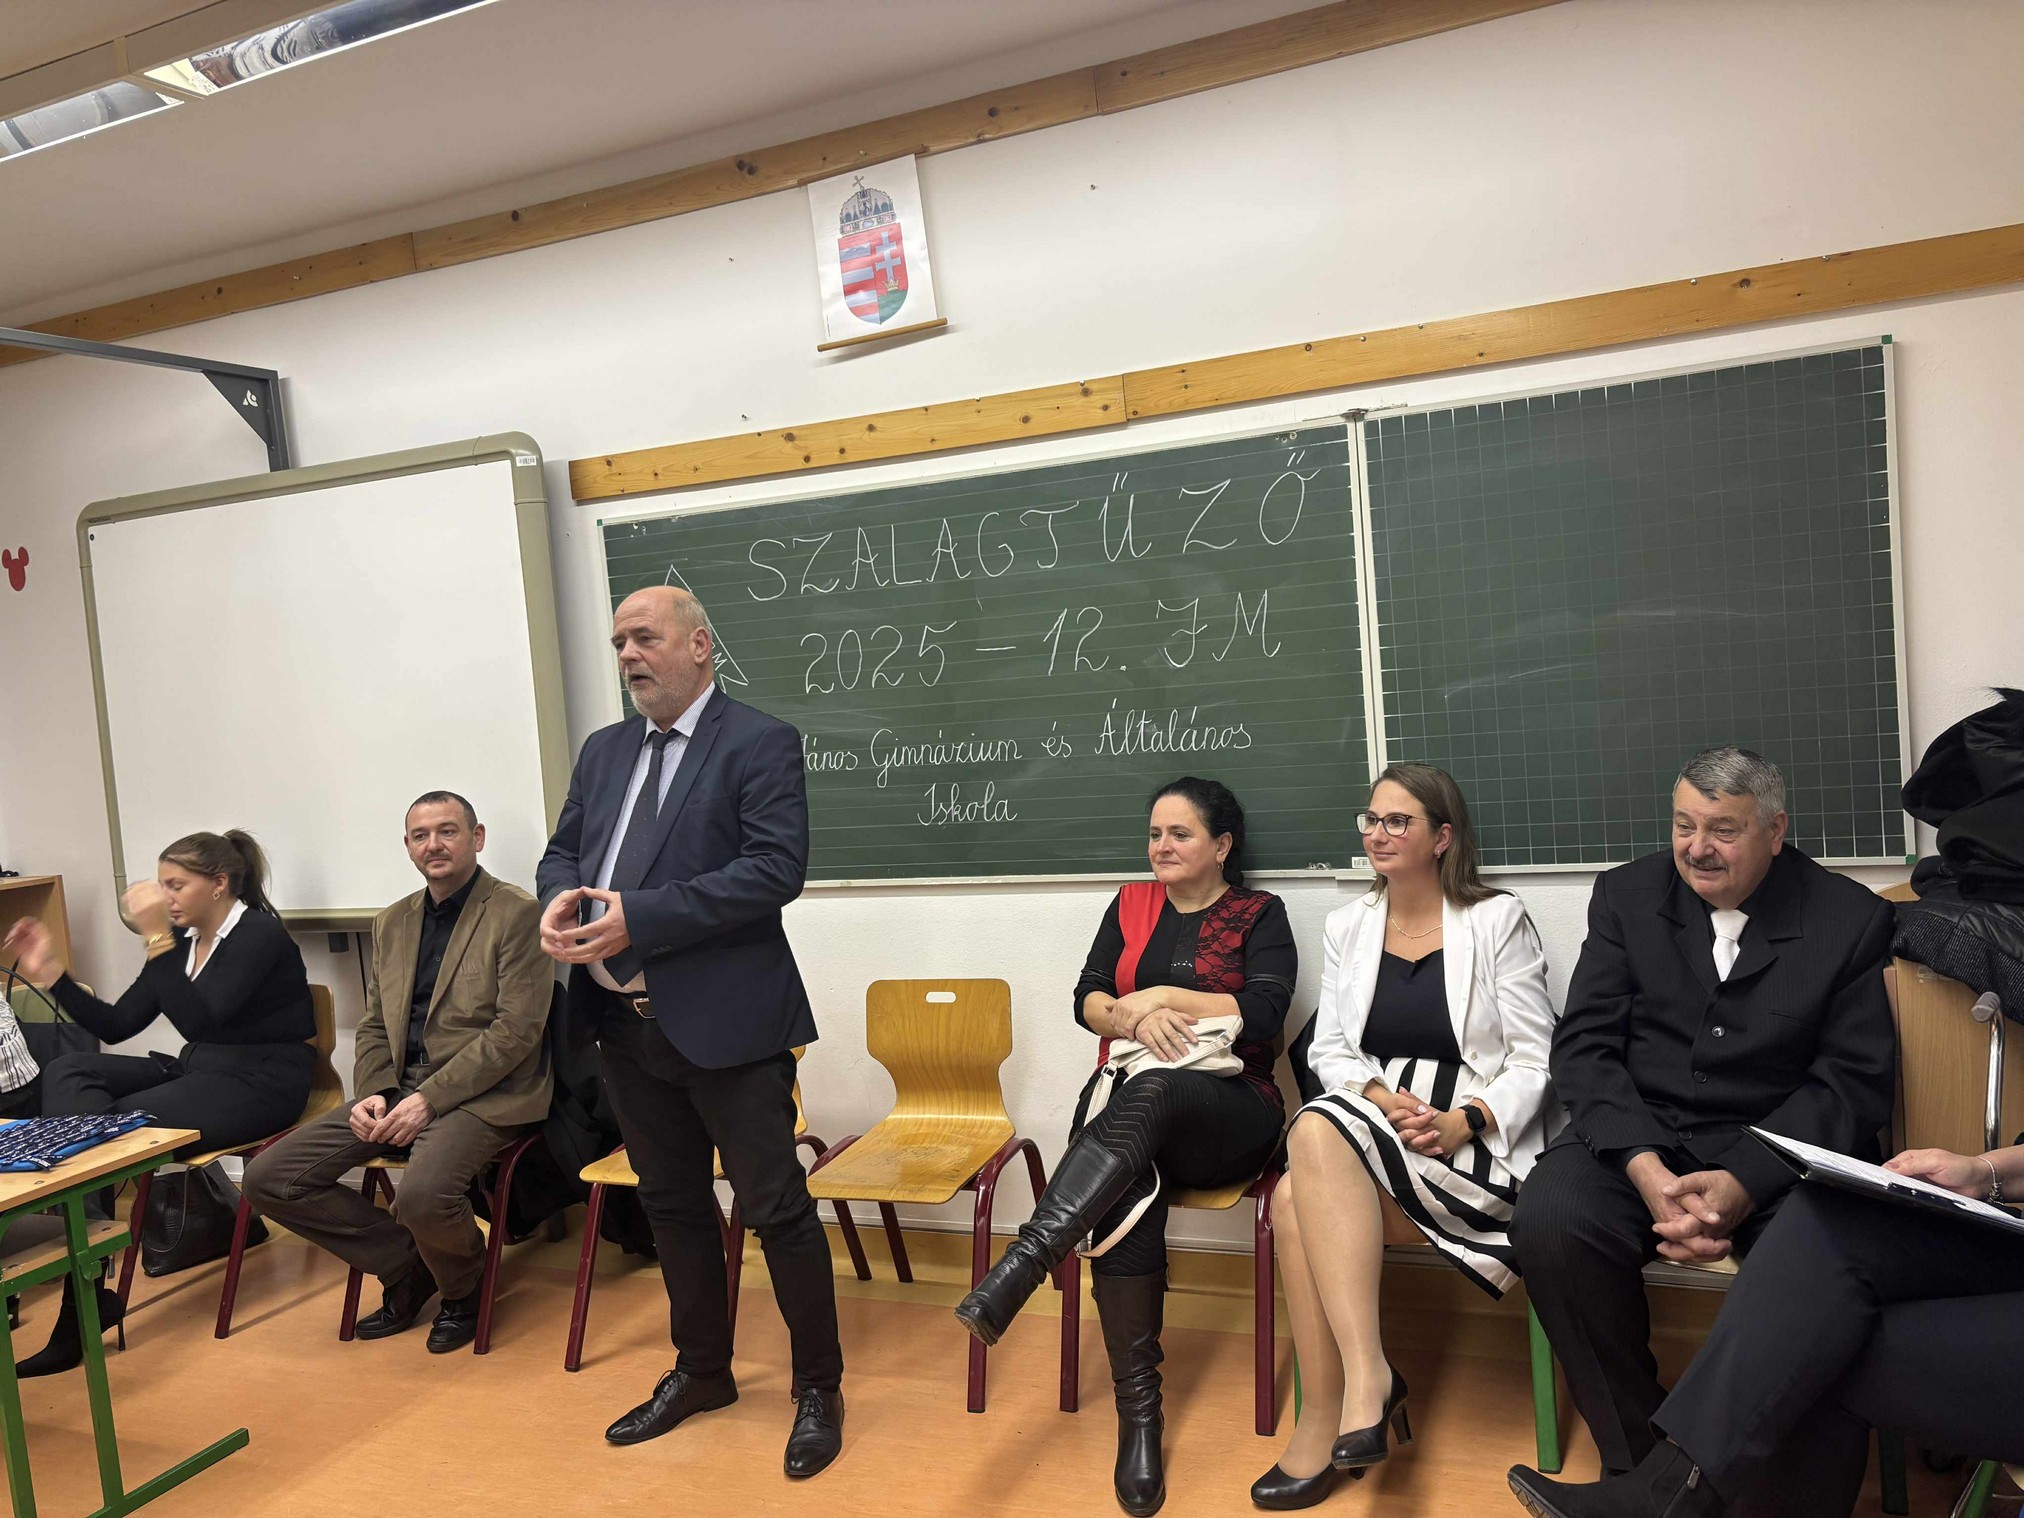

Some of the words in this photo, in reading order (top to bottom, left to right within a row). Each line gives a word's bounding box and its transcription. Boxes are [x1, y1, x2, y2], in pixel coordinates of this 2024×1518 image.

[800, 620, 957, 694] 2025
[1043, 607, 1127, 676] 12.
[870, 728, 1023, 788] Gimnázium
[1041, 721, 1073, 758] és
[1095, 698, 1252, 755] Általános
[917, 780, 1018, 826] Iskola
